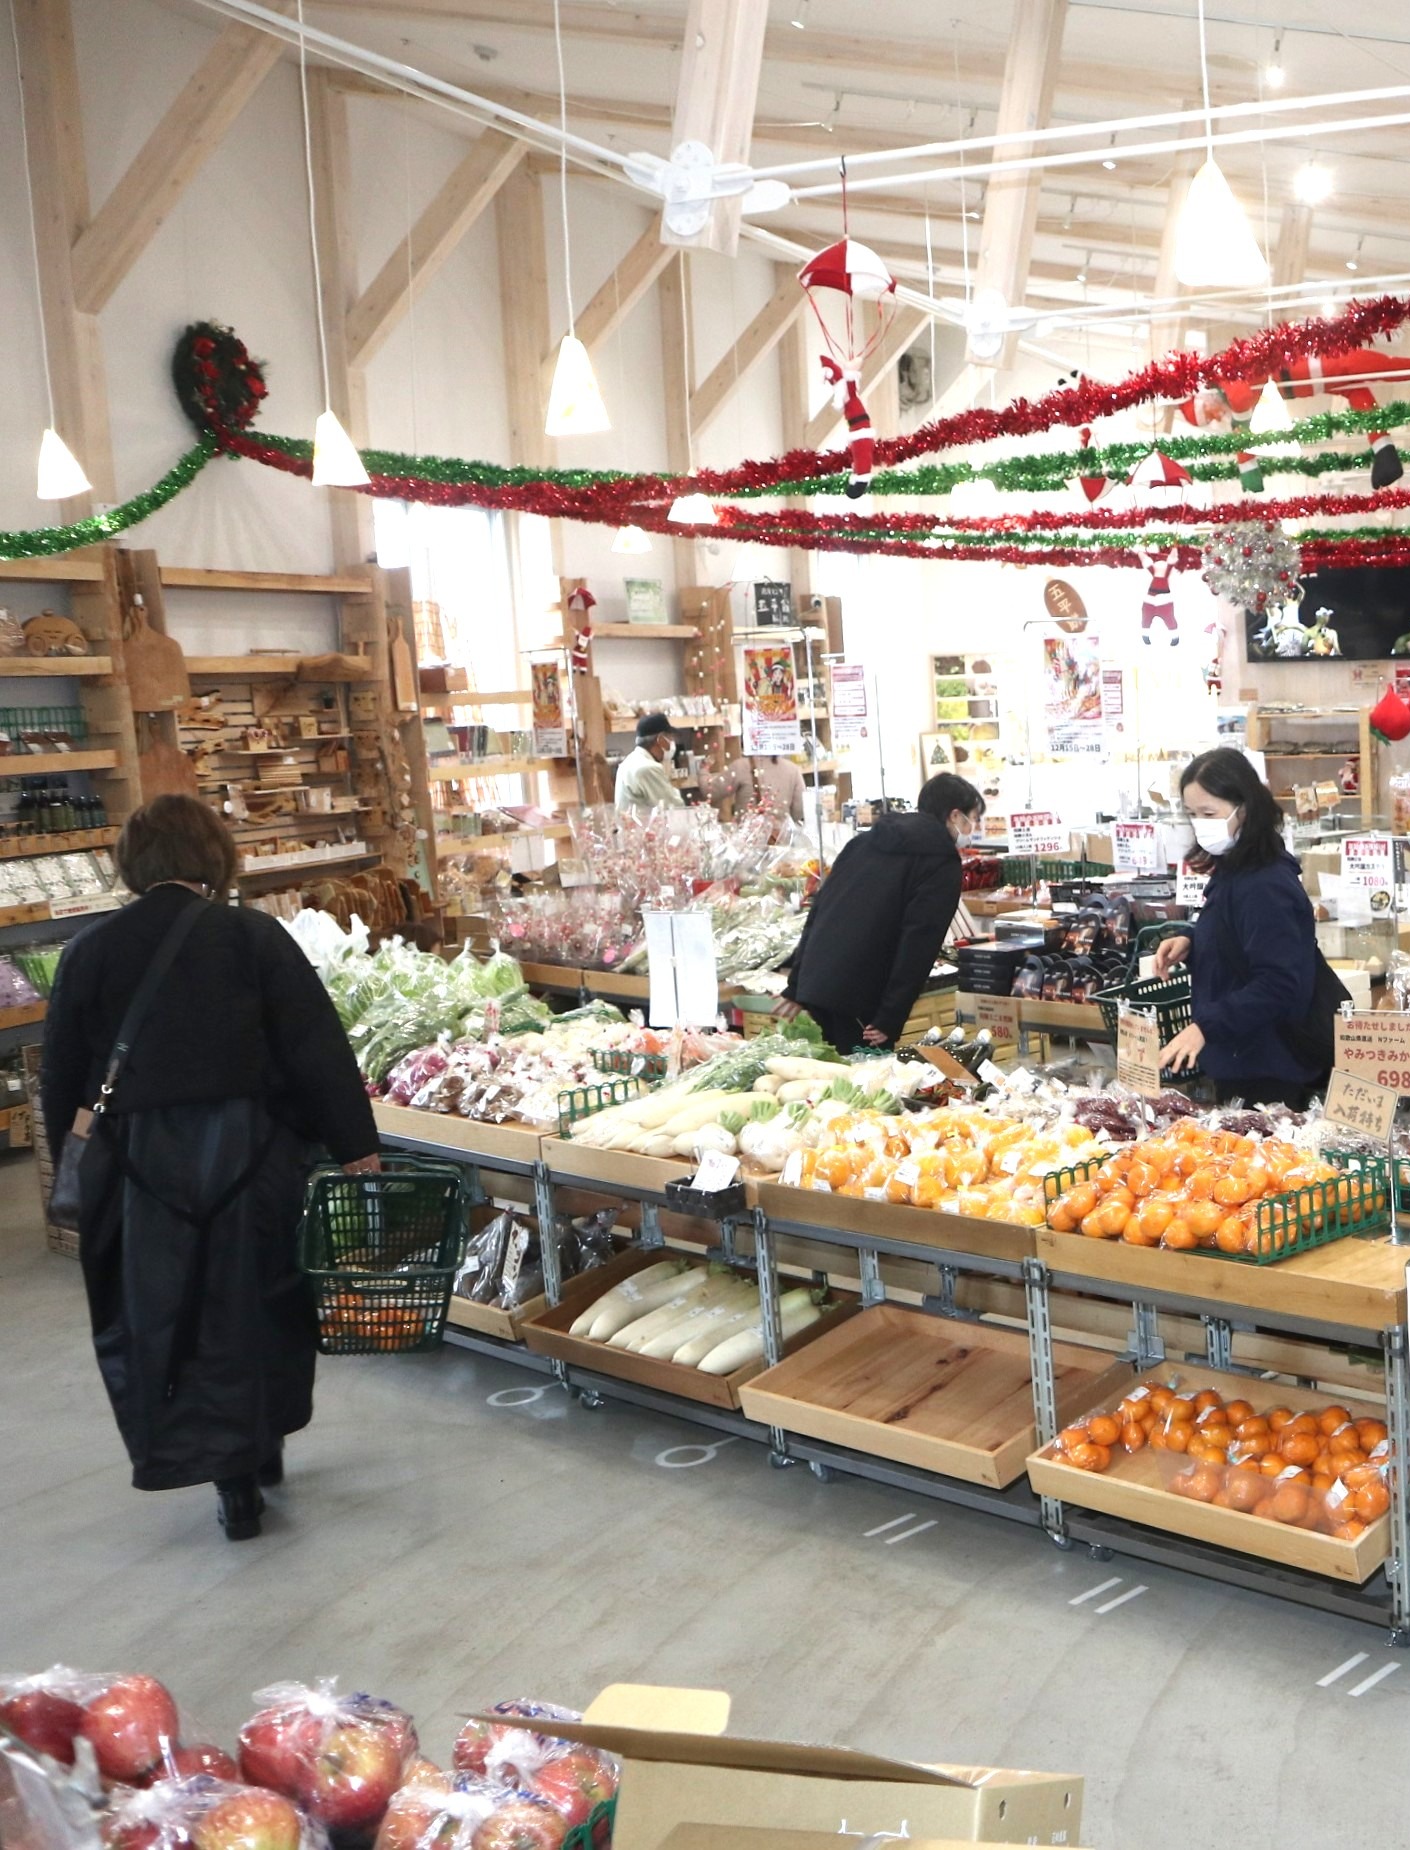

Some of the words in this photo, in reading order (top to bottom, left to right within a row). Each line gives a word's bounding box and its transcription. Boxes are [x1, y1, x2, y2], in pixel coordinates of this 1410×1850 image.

[1343, 1082, 1384, 1108] ただいま
[1333, 1103, 1383, 1132] 入荷待ち
